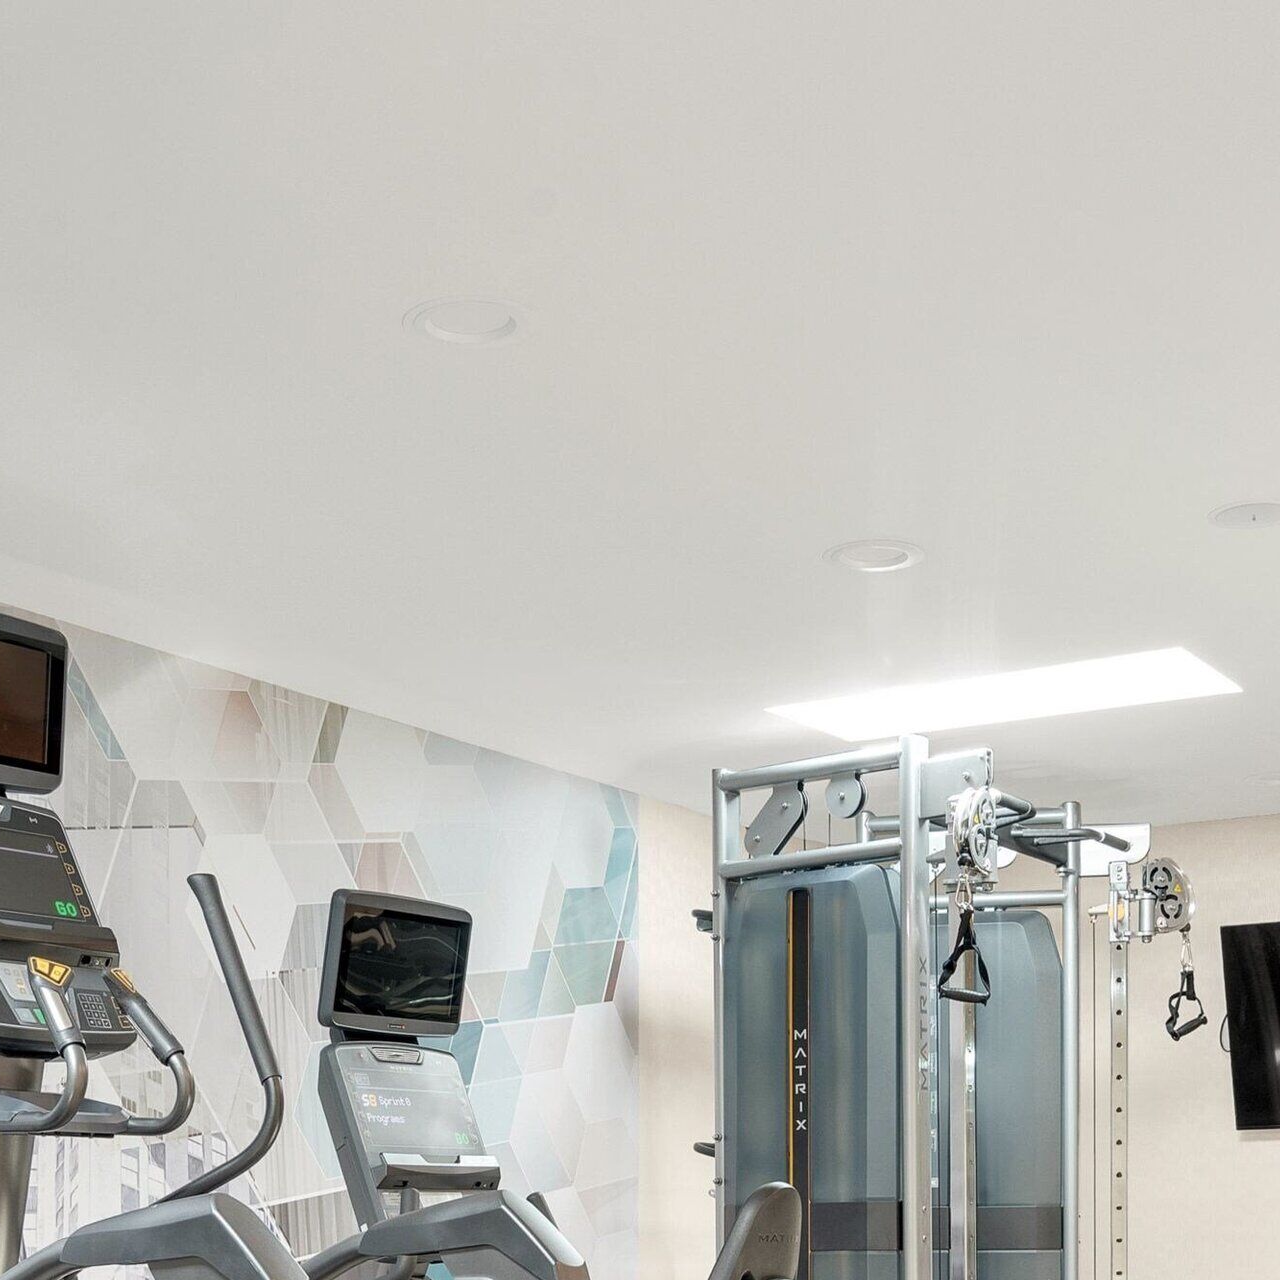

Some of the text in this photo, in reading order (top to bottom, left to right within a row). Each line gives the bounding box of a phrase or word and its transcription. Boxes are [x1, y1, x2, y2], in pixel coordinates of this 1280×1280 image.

[54, 901, 78, 918] GO
[920, 957, 929, 1090] MATRIX
[794, 1028, 808, 1131] MATRIX
